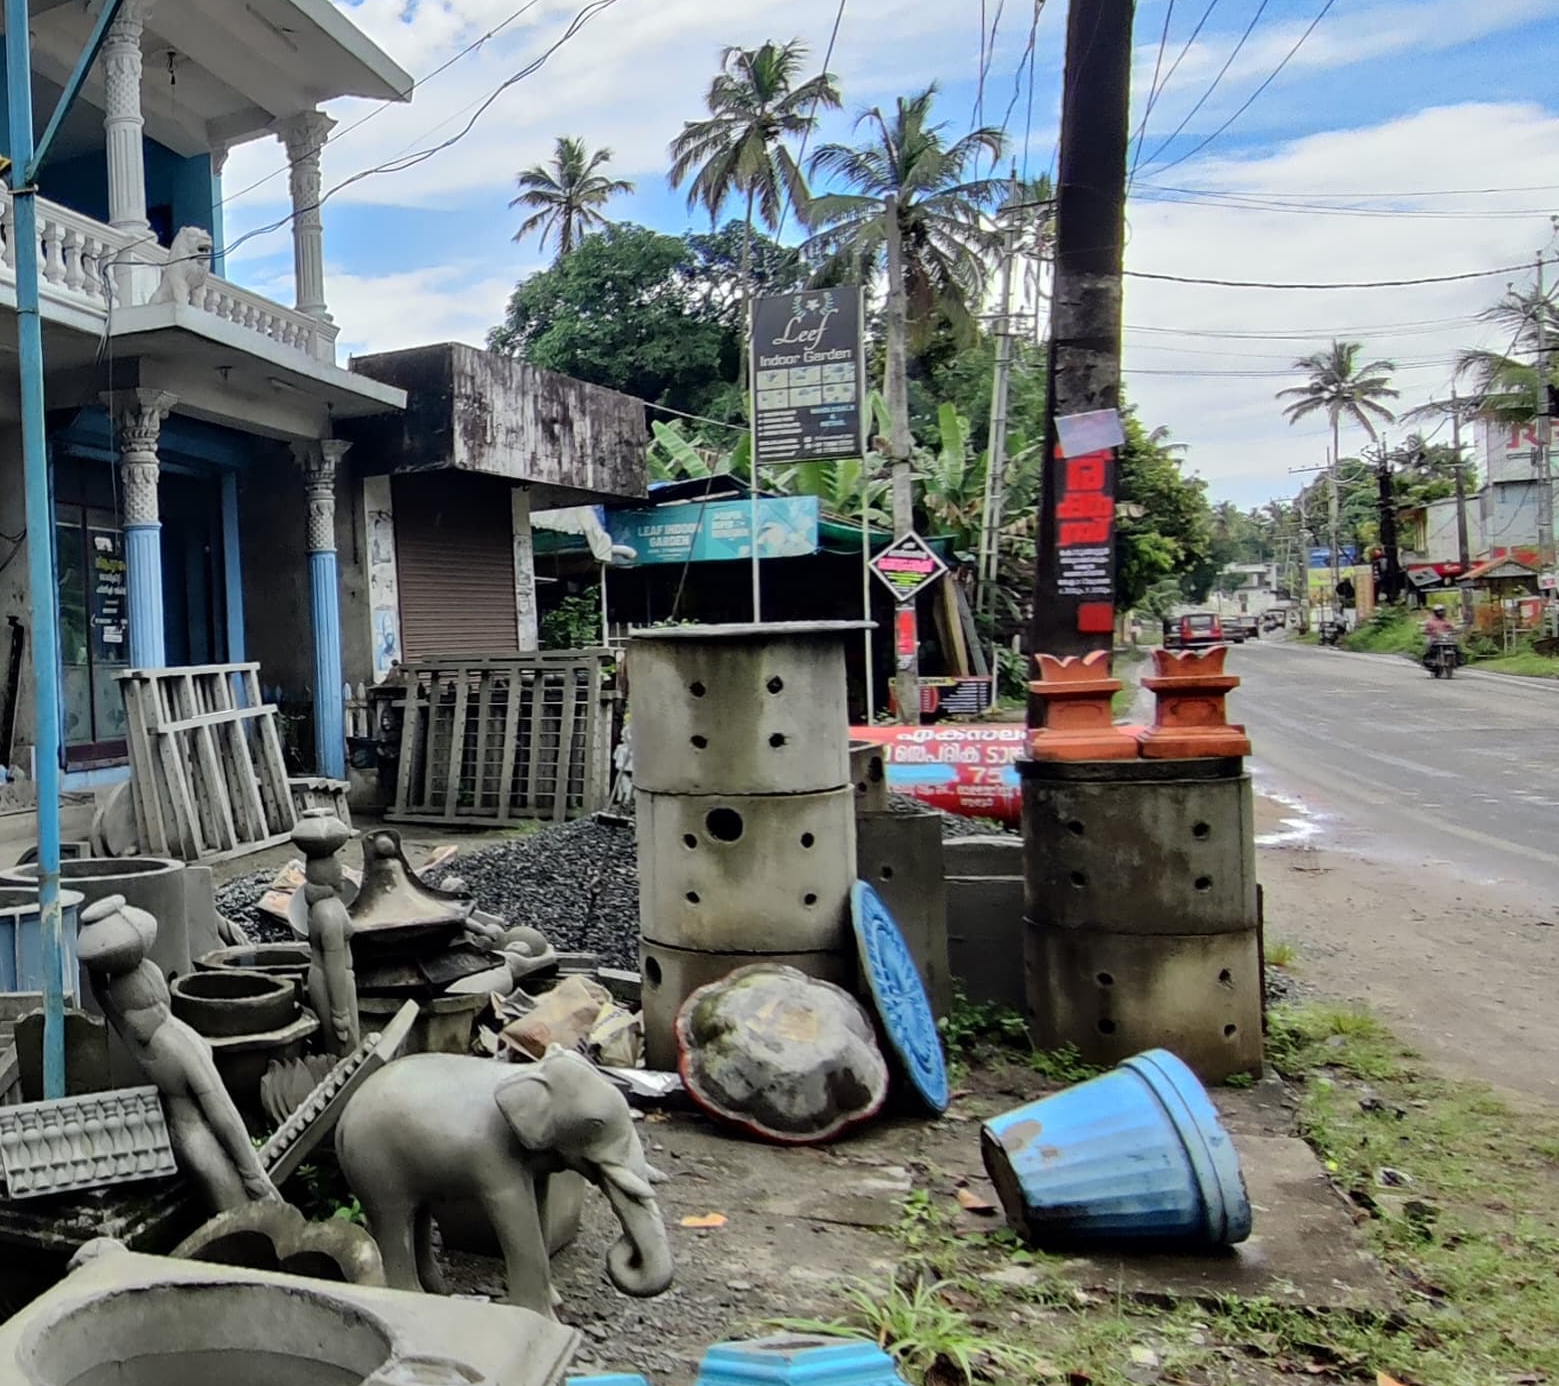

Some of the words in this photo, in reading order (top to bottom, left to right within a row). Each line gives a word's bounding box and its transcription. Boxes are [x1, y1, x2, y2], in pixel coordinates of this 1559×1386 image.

[772, 308, 839, 350] Leef
[760, 354, 800, 367] Indoor
[803, 348, 852, 363] Garden
